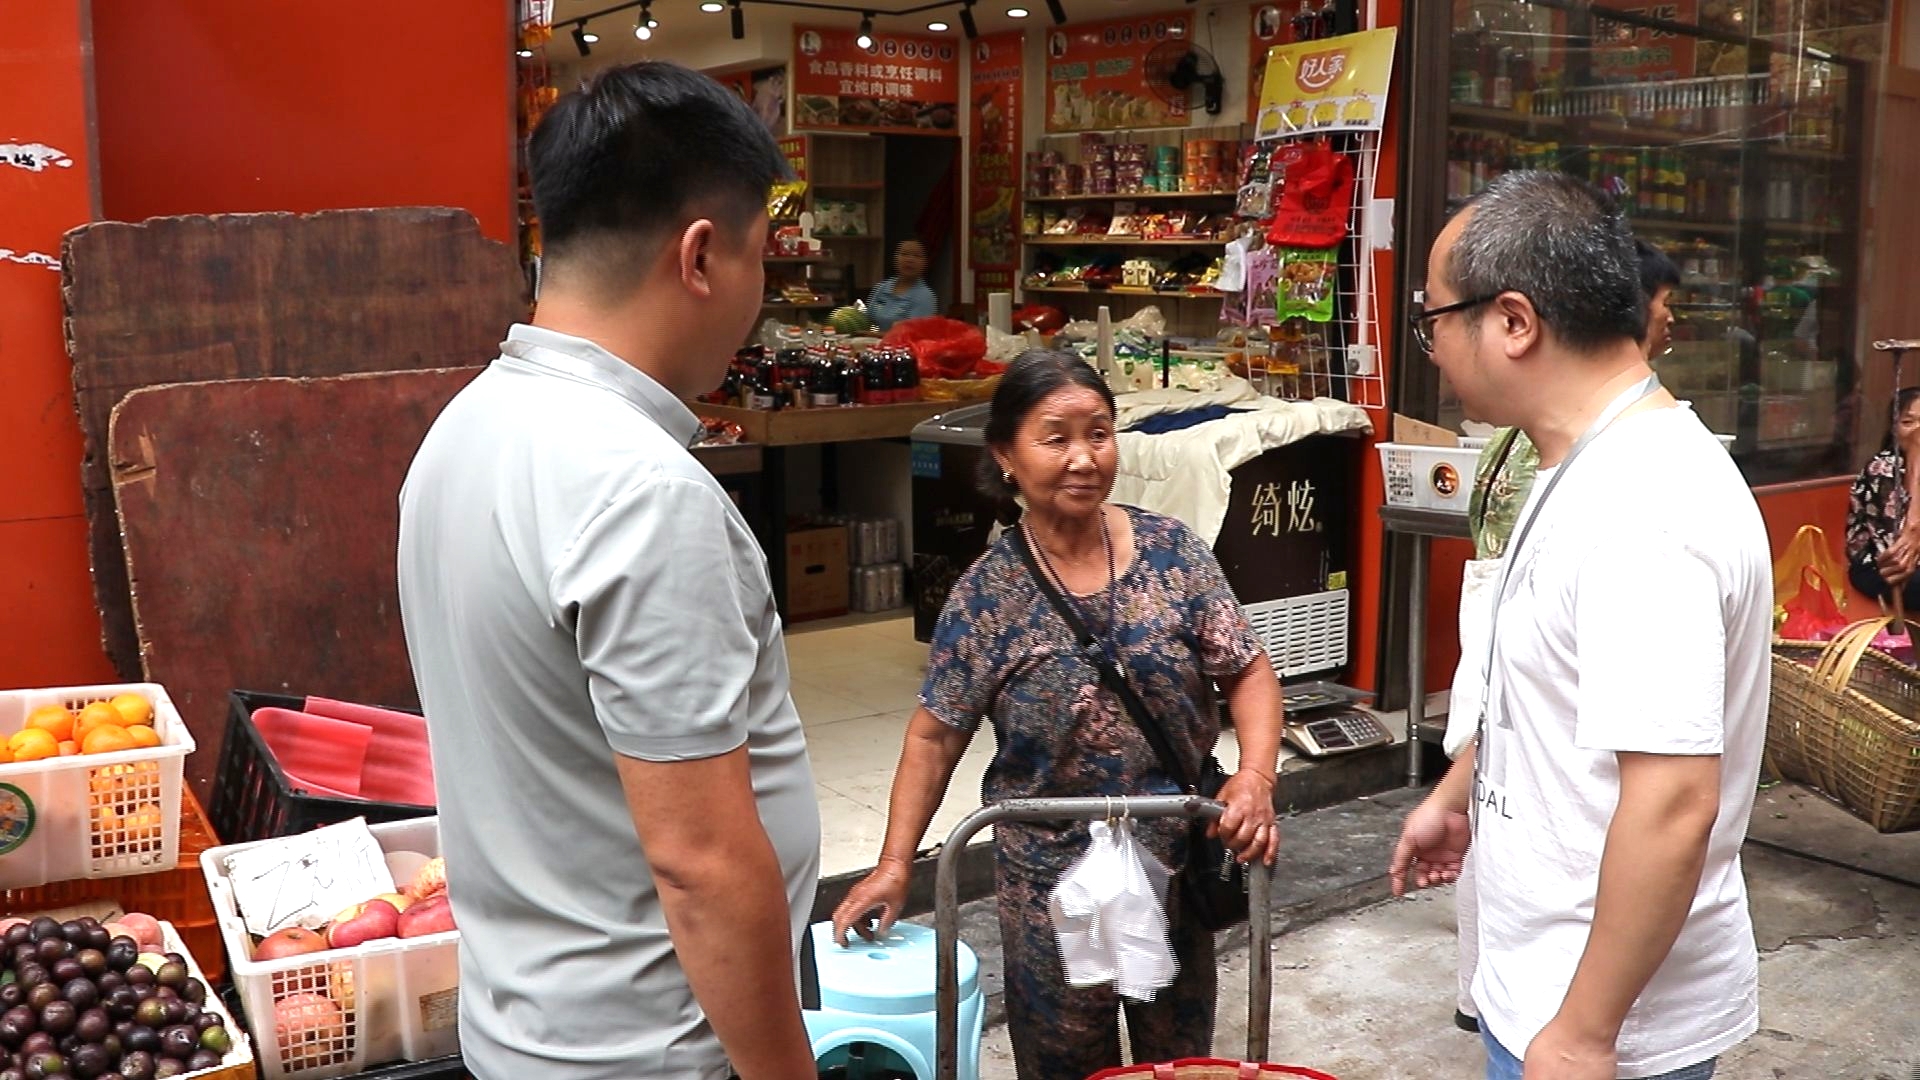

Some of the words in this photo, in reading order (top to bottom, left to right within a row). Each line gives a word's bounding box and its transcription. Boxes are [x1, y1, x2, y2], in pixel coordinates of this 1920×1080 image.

[808, 60, 943, 83] 食品香料或烹饪调料
[1299, 54, 1346, 79] 好人家
[839, 80, 914, 97] 宜炖肉调味
[1251, 479, 1315, 537] 绮炫
